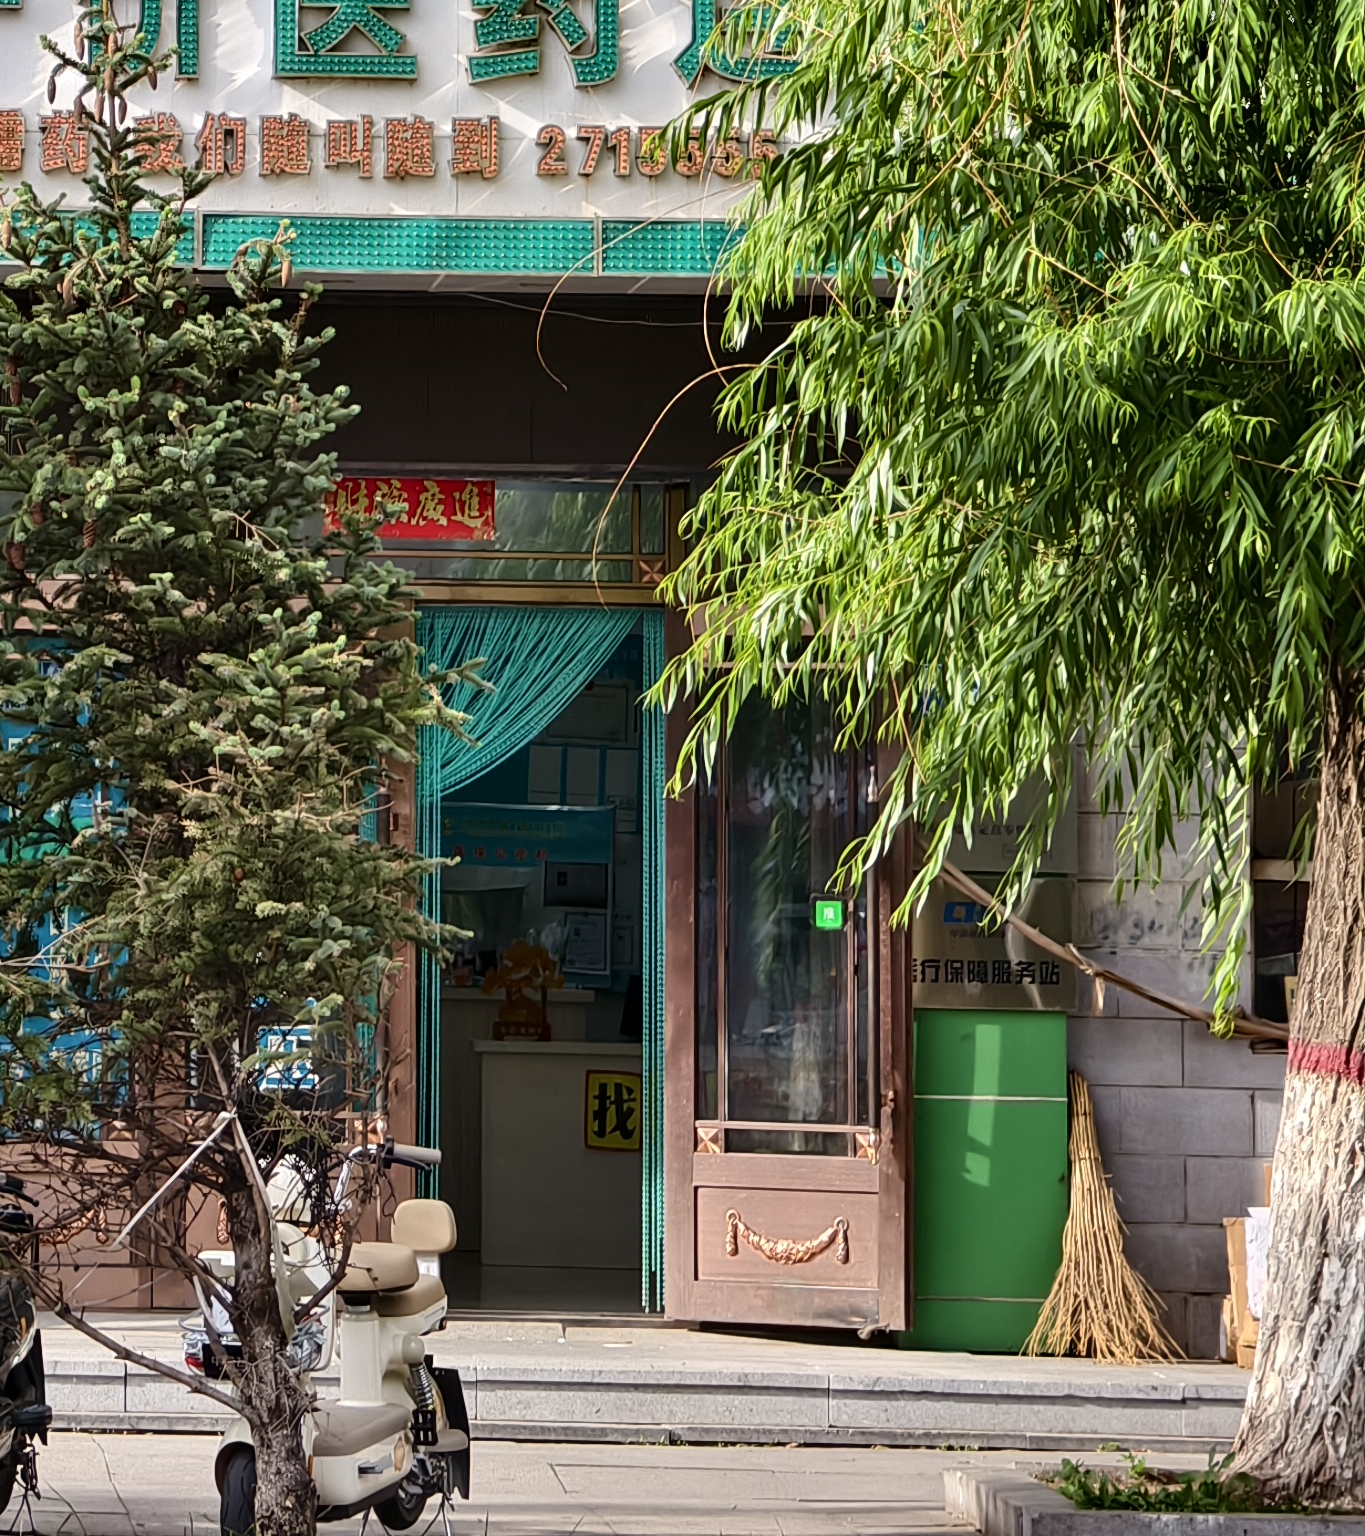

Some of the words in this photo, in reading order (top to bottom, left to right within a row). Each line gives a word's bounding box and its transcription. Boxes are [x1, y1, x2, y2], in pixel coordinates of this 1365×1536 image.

[912, 957, 1061, 986] 疗保障服务站
[591, 1082, 637, 1140] 找
